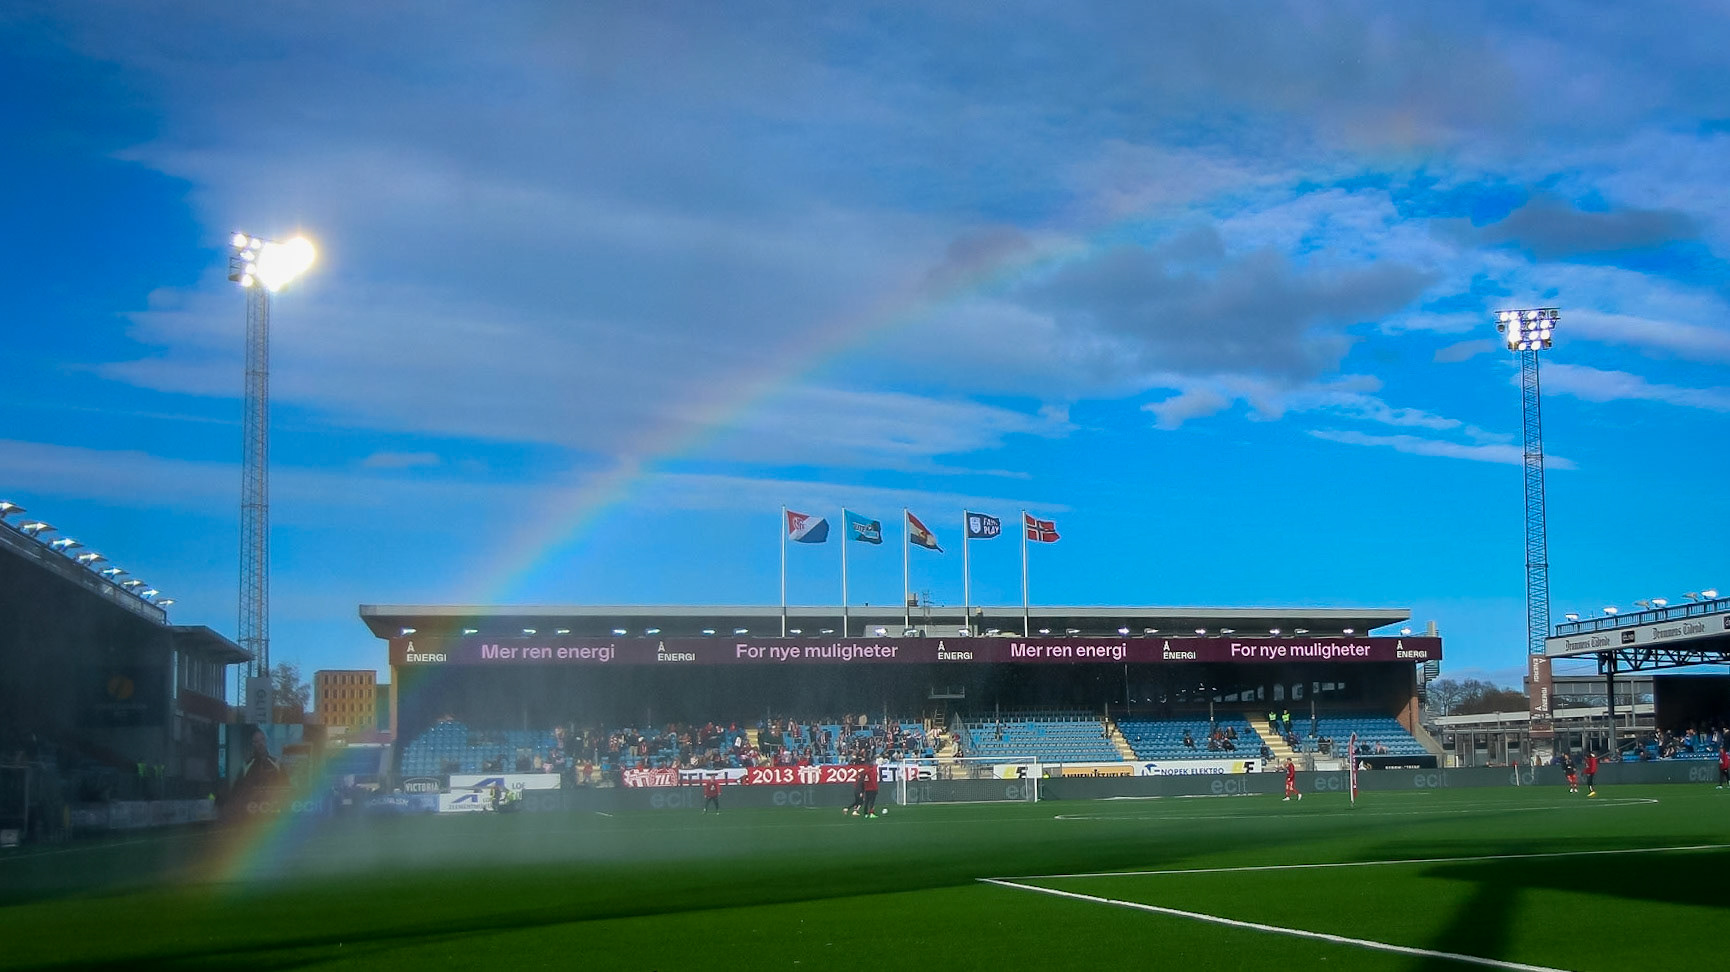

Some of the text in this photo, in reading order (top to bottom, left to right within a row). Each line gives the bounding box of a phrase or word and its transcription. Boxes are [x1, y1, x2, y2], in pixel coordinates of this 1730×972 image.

[984, 526, 999, 535] PLAY
[406, 641, 415, 652] Å
[657, 641, 666, 652] Å
[937, 641, 946, 651] Å
[1163, 640, 1170, 651] Å
[1231, 643, 1371, 659] For nye muligheter
[481, 644, 615, 662] Mer ren energi
[657, 653, 696, 661] ENERGI
[736, 643, 899, 661] For nye muligheter
[937, 652, 973, 660] ENERGI
[1011, 643, 1127, 660] Mer ren energi
[1163, 651, 1196, 660] ENERGI
[1396, 650, 1428, 658] ENERGI
[406, 653, 447, 662] ENERGI
[752, 768, 794, 784] 2013
[1414, 771, 1448, 788] ecit
[405, 782, 440, 792] VICTORIA
[1211, 776, 1248, 793] ecit
[650, 791, 694, 808] ecit
[773, 788, 815, 806] ecit
